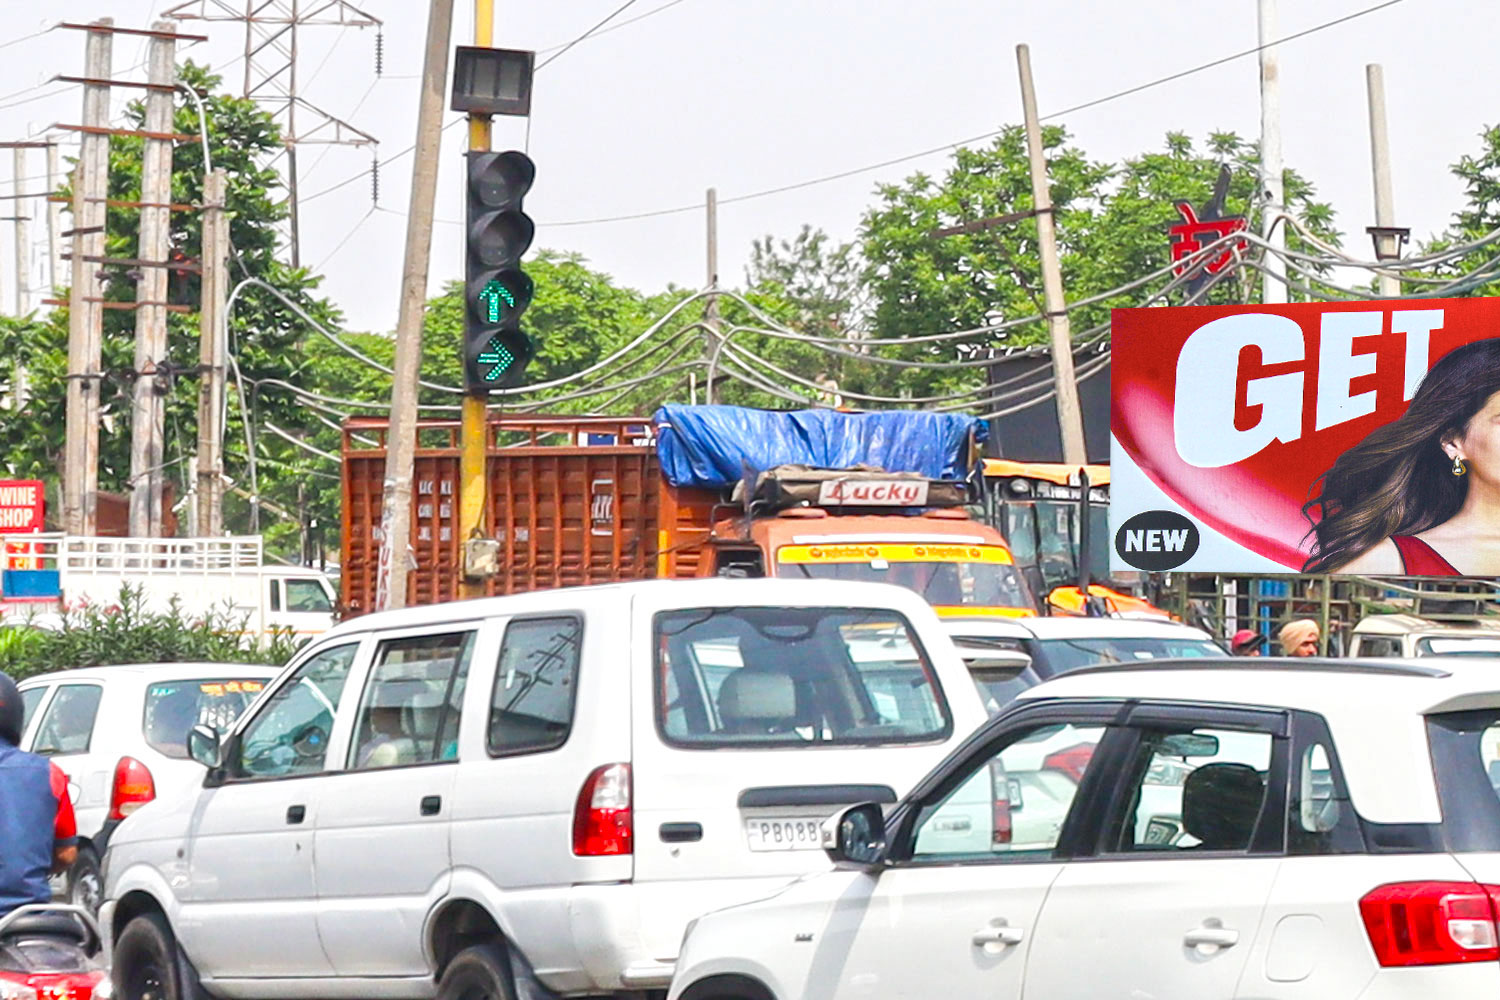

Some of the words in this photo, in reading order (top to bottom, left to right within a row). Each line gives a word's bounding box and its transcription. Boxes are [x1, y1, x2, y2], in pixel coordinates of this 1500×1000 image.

[1173, 308, 1444, 468] GET
[0, 487, 36, 505] WINE
[826, 482, 919, 505] Lucky
[1125, 529, 1188, 552] NEW
[760, 821, 825, 842] PB08B
